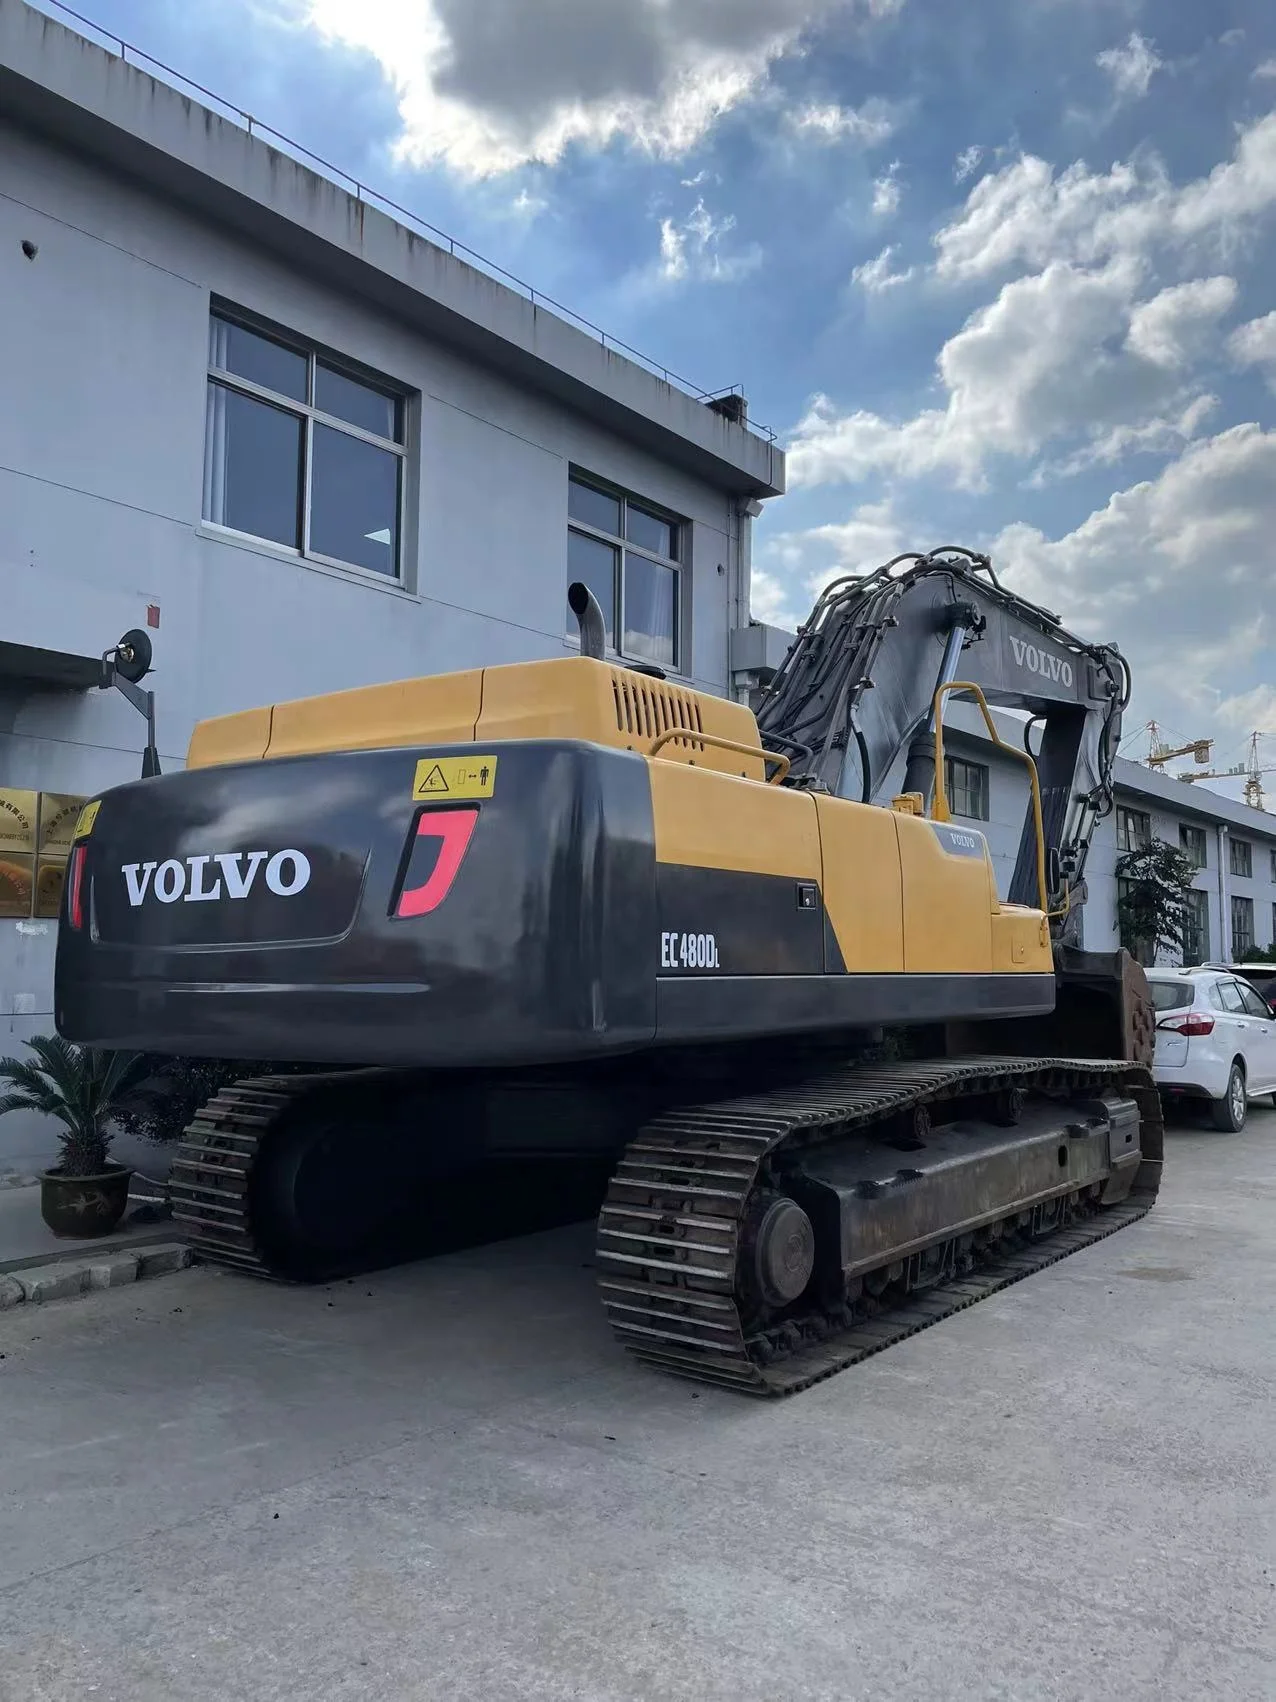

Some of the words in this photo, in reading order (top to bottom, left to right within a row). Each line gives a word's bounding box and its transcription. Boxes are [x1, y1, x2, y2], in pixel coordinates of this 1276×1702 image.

[1009, 635, 1073, 688] VOLVO
[950, 832, 975, 848] VOLVO
[121, 848, 311, 907] VOLVO
